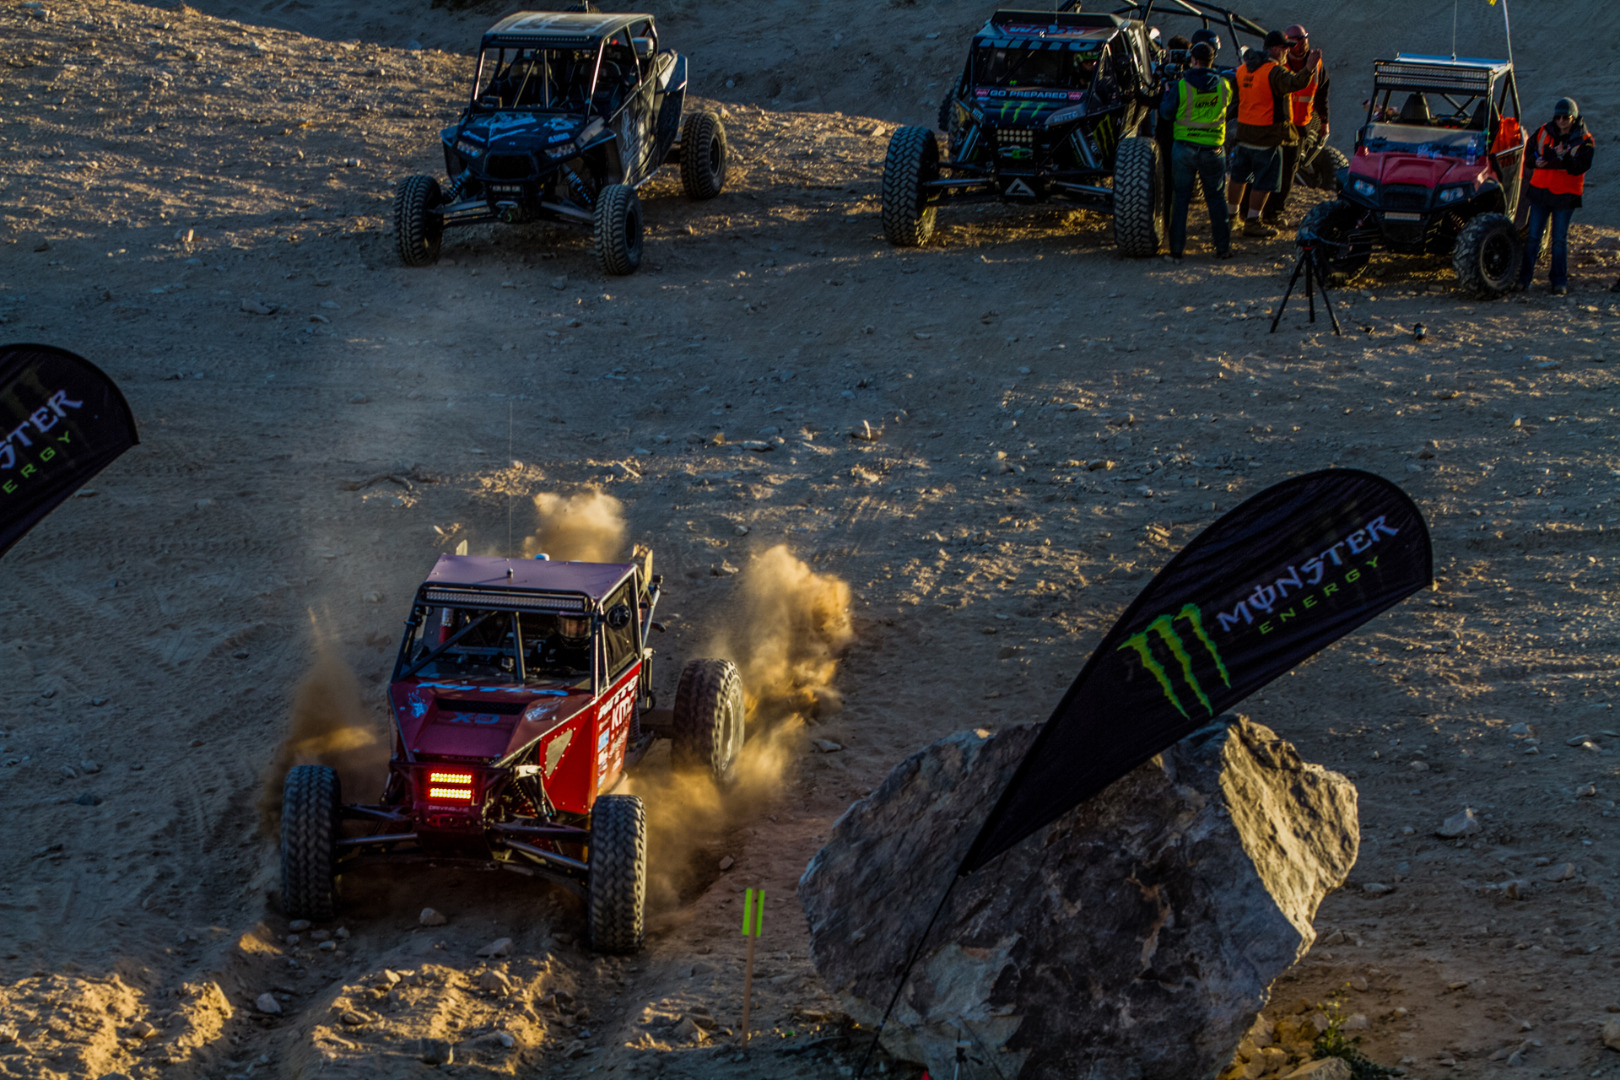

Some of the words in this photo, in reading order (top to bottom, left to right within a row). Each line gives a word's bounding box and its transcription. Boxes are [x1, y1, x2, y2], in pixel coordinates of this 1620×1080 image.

[979, 36, 1098, 51] NITTO
[1009, 90, 1068, 99] PREPARED
[1216, 515, 1400, 632] MONSTER
[1259, 556, 1379, 634] ENERGY
[597, 674, 639, 721] NITTO
